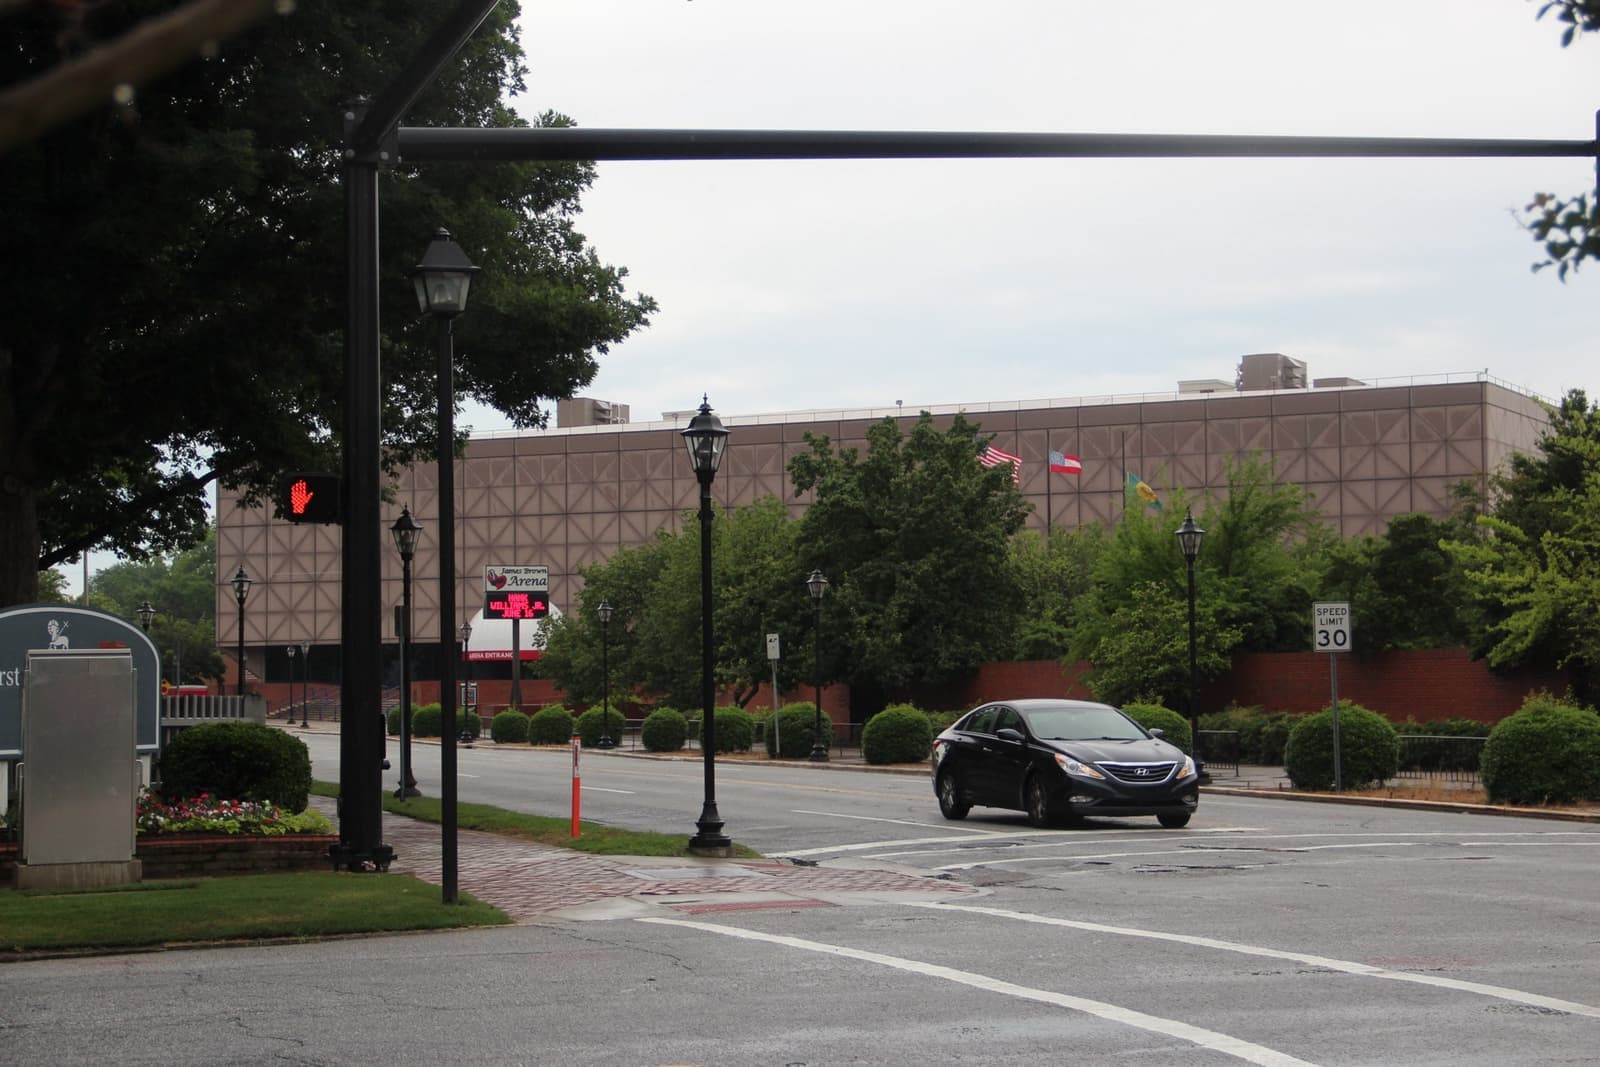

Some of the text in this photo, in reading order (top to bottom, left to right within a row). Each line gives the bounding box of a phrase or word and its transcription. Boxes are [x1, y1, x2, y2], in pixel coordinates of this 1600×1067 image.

[507, 576, 547, 586] Arena
[490, 602, 529, 610] WILLIAMS
[1316, 608, 1347, 616] SPEED
[1318, 629, 1347, 647] 30
